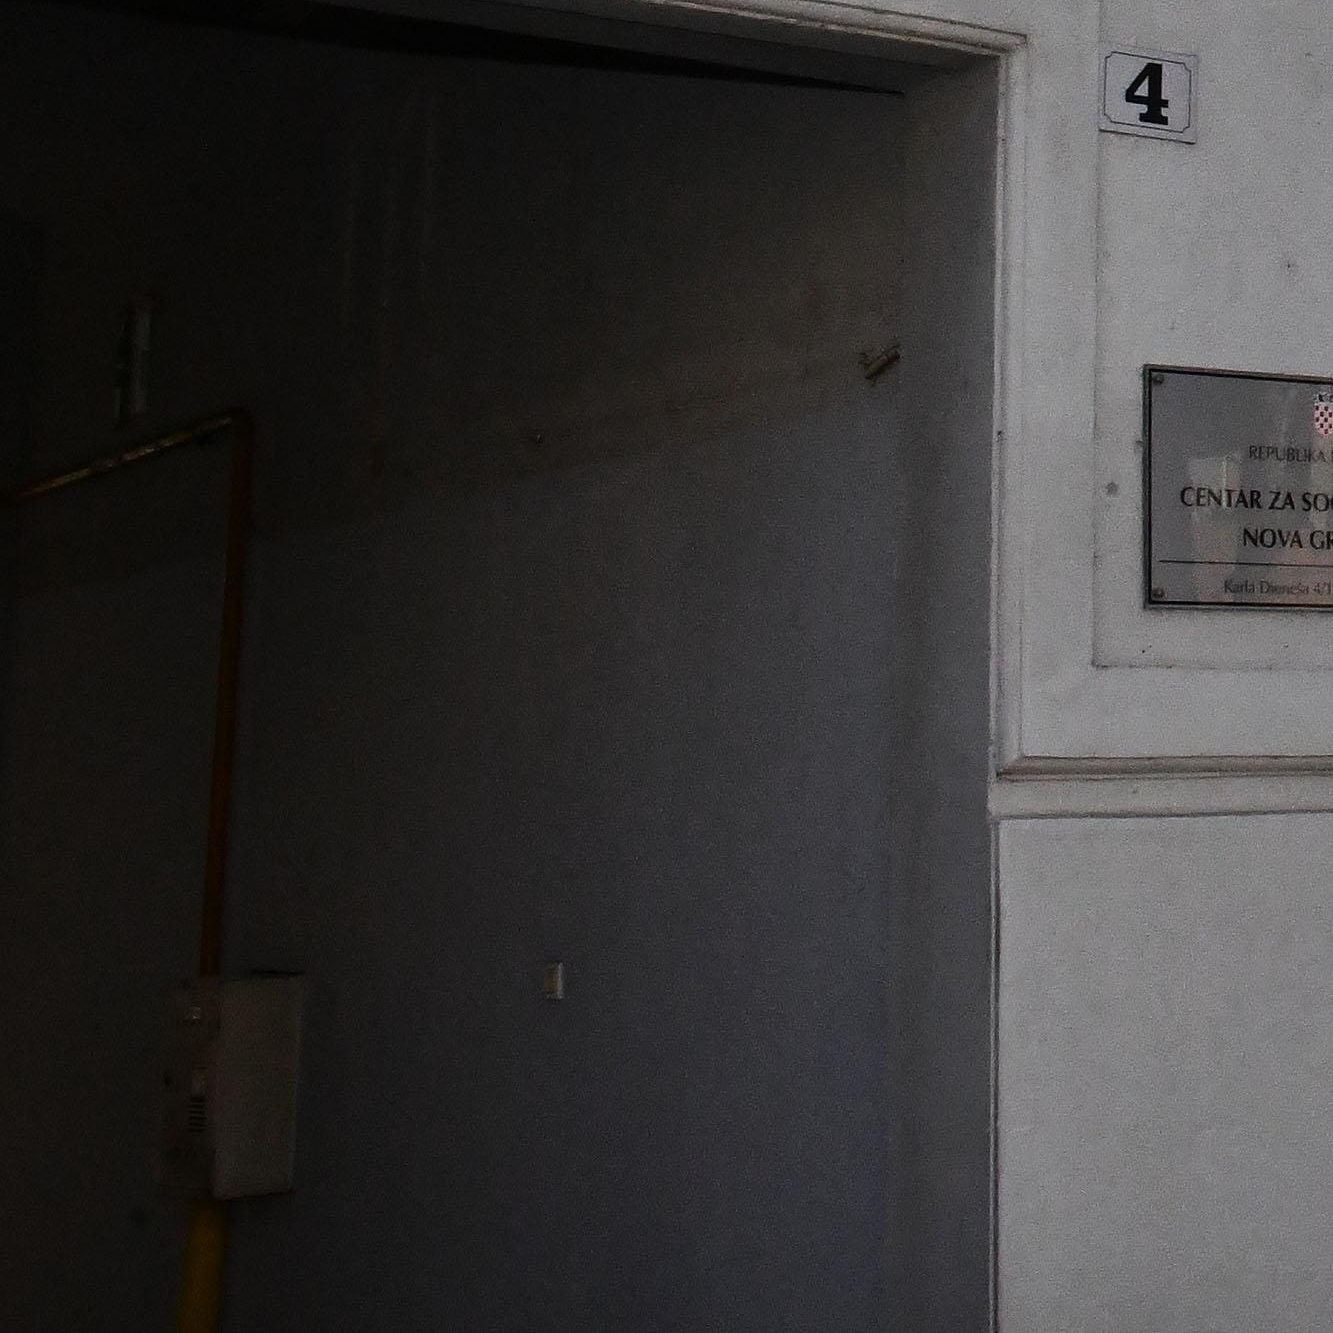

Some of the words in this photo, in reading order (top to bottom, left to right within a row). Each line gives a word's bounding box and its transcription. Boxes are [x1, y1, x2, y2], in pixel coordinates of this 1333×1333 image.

[1124, 61, 1170, 126] 4
[1249, 445, 1326, 463] REPUBLIKA
[1180, 486, 1262, 510] CENTAR
[1268, 490, 1296, 511] ZA
[1242, 528, 1303, 549] NOVA
[1223, 580, 1256, 595] Karla
